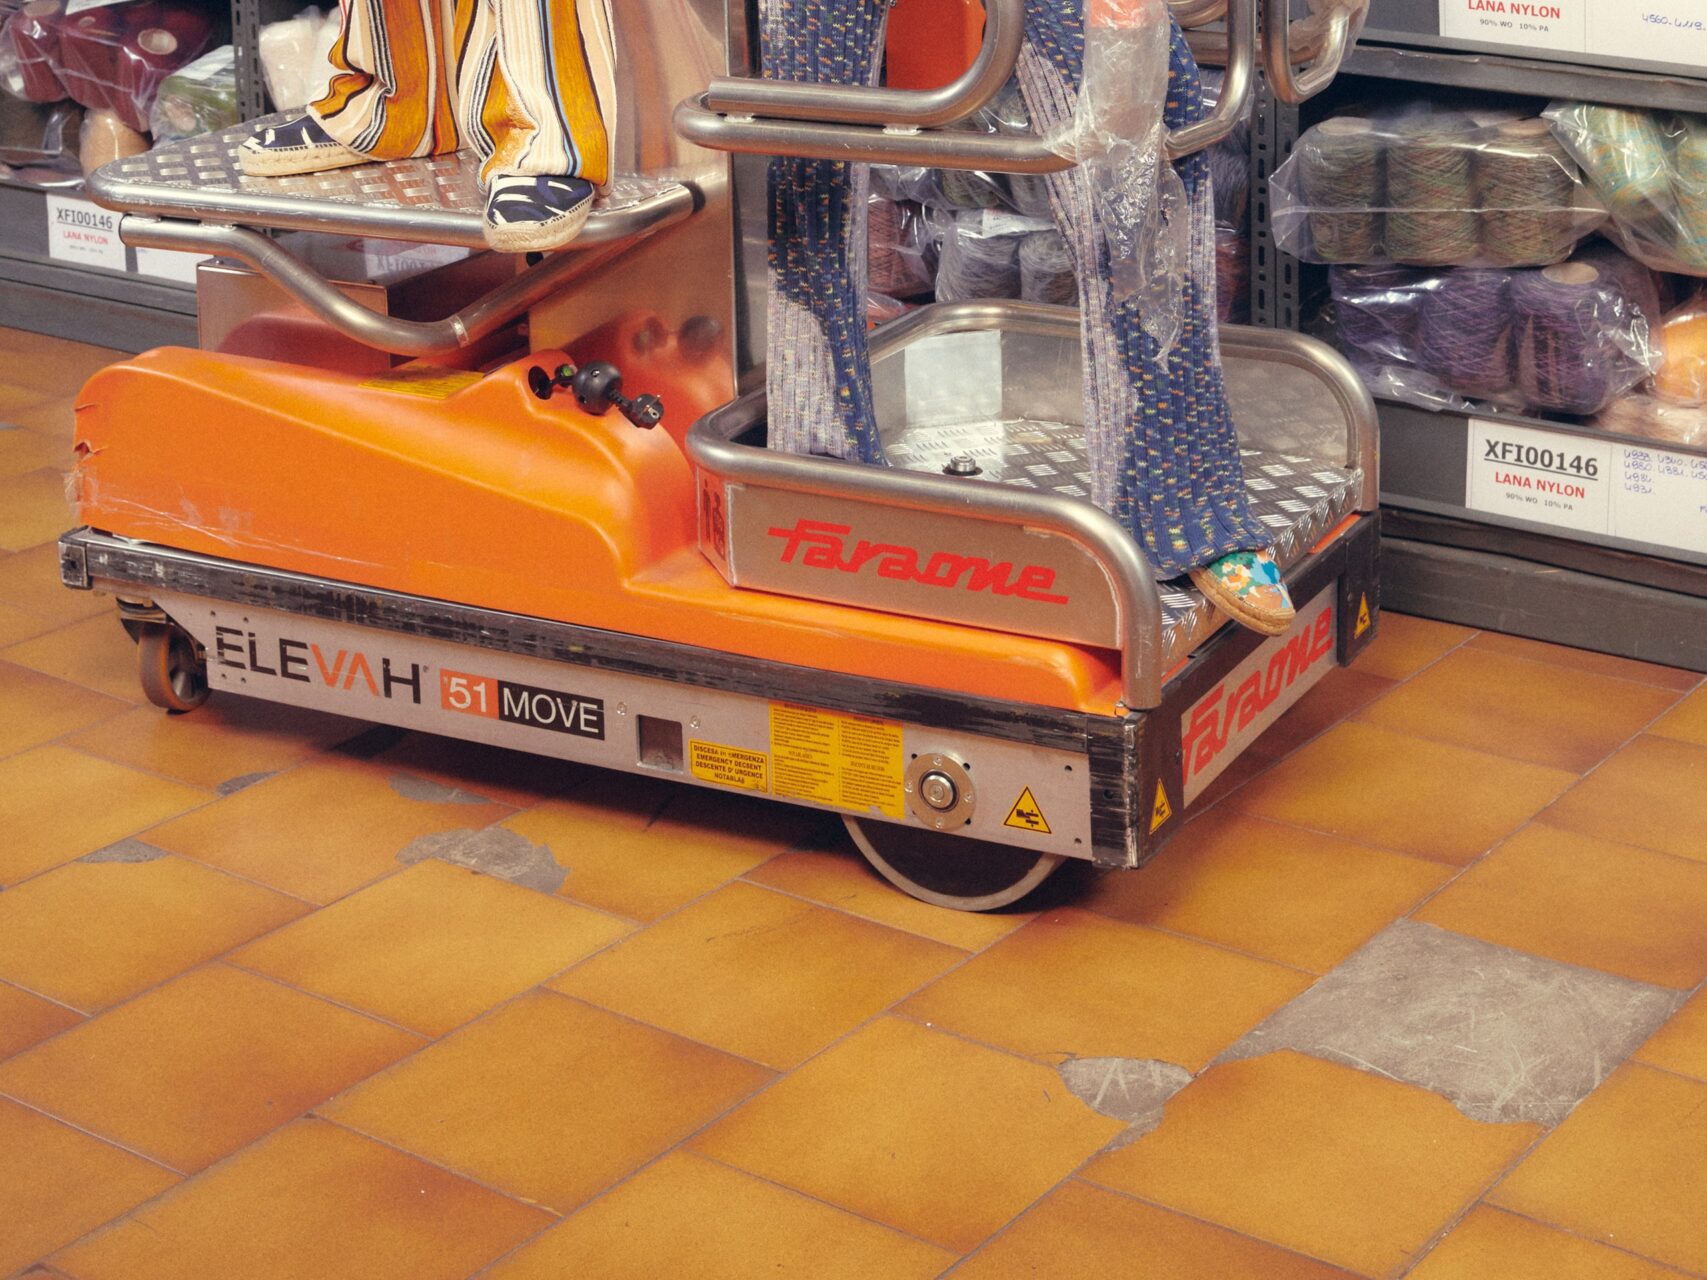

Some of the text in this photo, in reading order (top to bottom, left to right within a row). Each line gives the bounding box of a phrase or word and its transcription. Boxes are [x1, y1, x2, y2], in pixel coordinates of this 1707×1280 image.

[1510, 4, 1560, 18] NYLON
[1480, 18, 1498, 28] 90%
[1519, 22, 1538, 30] 10%
[57, 208, 113, 230] XFI00146
[64, 230, 108, 245] LANA NYLON
[1484, 439, 1598, 477] XFI00146
[1495, 472, 1585, 498] LANA NYLON
[1506, 492, 1524, 502] 90%
[1525, 496, 1538, 504] WO
[1544, 499, 1562, 508] 10%
[767, 519, 1069, 605] Faraone
[215, 625, 601, 734] ELEVAH 51 MOVE
[1182, 606, 1335, 786] Faraone
[696, 752, 733, 766] EMERGENCY
[696, 760, 726, 772] DESCENTE
